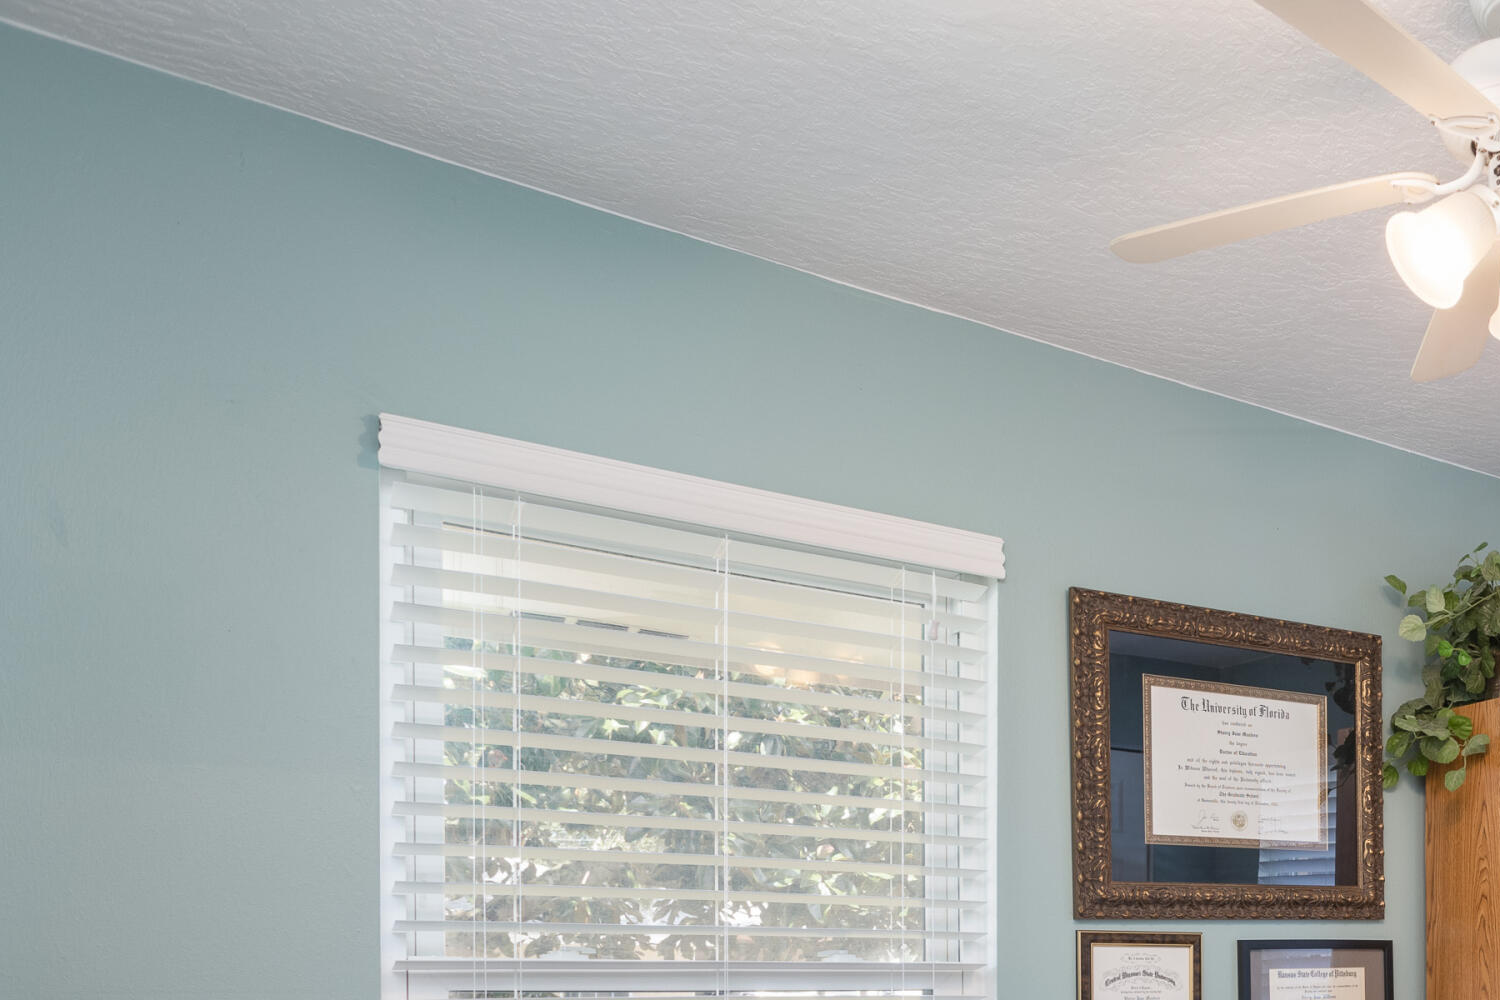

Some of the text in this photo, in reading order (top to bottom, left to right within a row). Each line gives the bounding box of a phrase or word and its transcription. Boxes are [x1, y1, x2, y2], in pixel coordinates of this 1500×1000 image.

[1180, 696, 1290, 720] The University of Florida
[1310, 969, 1328, 979] College
